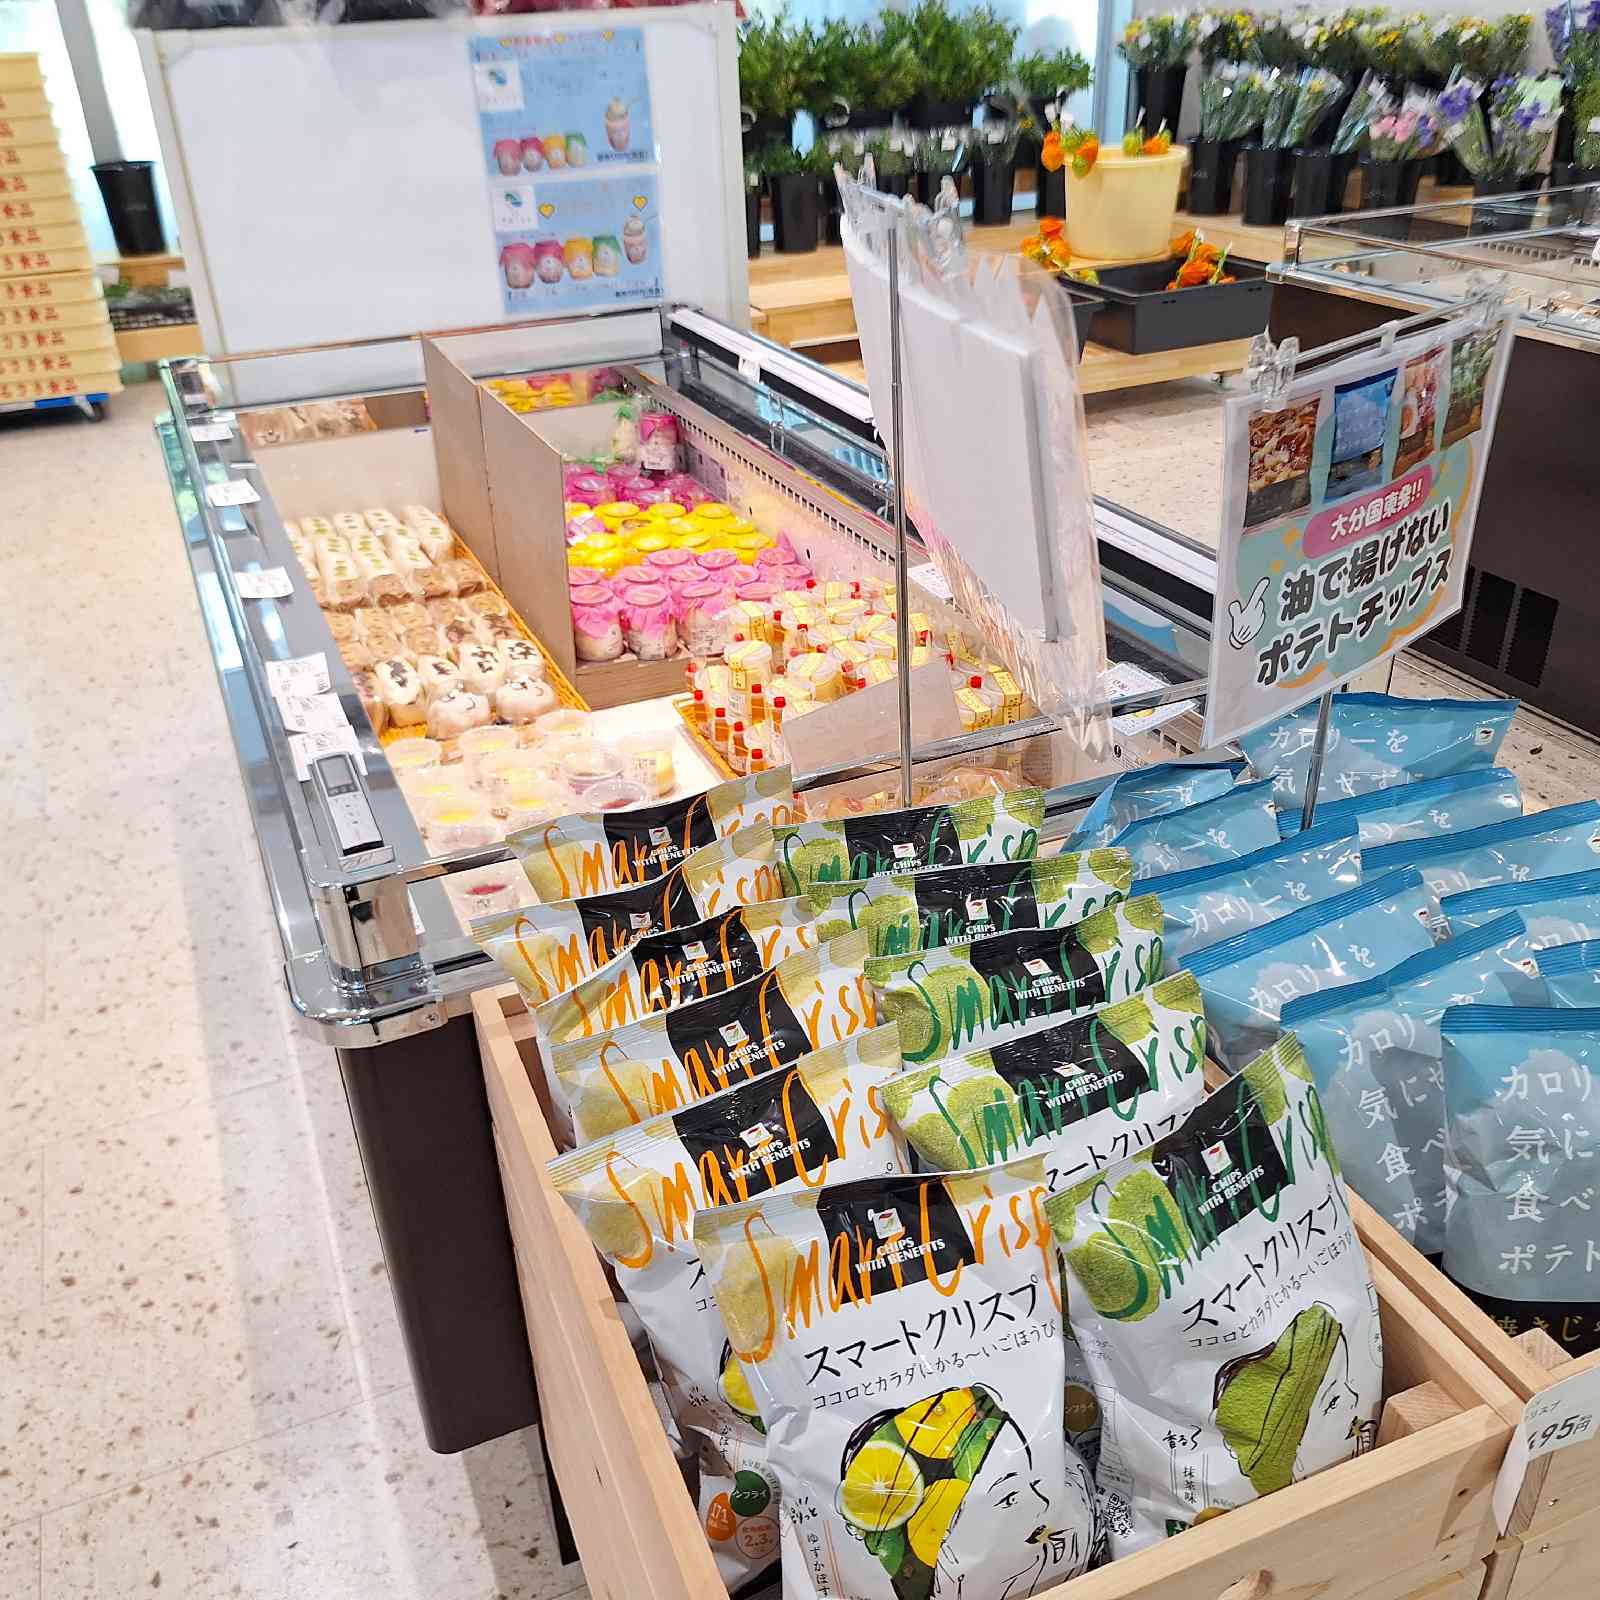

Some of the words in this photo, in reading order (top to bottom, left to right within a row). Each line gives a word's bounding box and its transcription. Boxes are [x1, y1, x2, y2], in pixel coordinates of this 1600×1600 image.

[1331, 479, 1424, 541] 大分国東発!!
[1280, 502, 1450, 622] 油で揚げない
[1257, 548, 1452, 686] ポテトチップス
[965, 923, 997, 935] CHIPS
[1014, 986, 1042, 1000] WITH
[1042, 979, 1086, 996] BENEFITS
[1031, 976, 1063, 988] CHIPS
[1045, 1090, 1076, 1110] WITH
[1076, 1071, 1125, 1098] BENEFITS
[1064, 1072, 1099, 1091] CHIPS
[1499, 1065, 1592, 1103] カロリ
[749, 1139, 785, 1159] CHIPS
[1505, 1124, 1594, 1165] 気に
[728, 1161, 762, 1181] WITH
[1211, 1168, 1243, 1194] CHIPS
[1198, 1194, 1224, 1217] WITH
[1505, 1177, 1595, 1224] 食べ
[854, 1256, 889, 1275] WITH
[888, 1238, 947, 1265] BENEFITS
[876, 1236, 915, 1256] CHIPS
[1182, 1183, 1340, 1333] スマートクリスプ
[1498, 1239, 1600, 1275] ポテト
[737, 1211, 906, 1363] Smart
[919, 1182, 1063, 1313] Crisp
[803, 1274, 1040, 1387] スマートクリスプ
